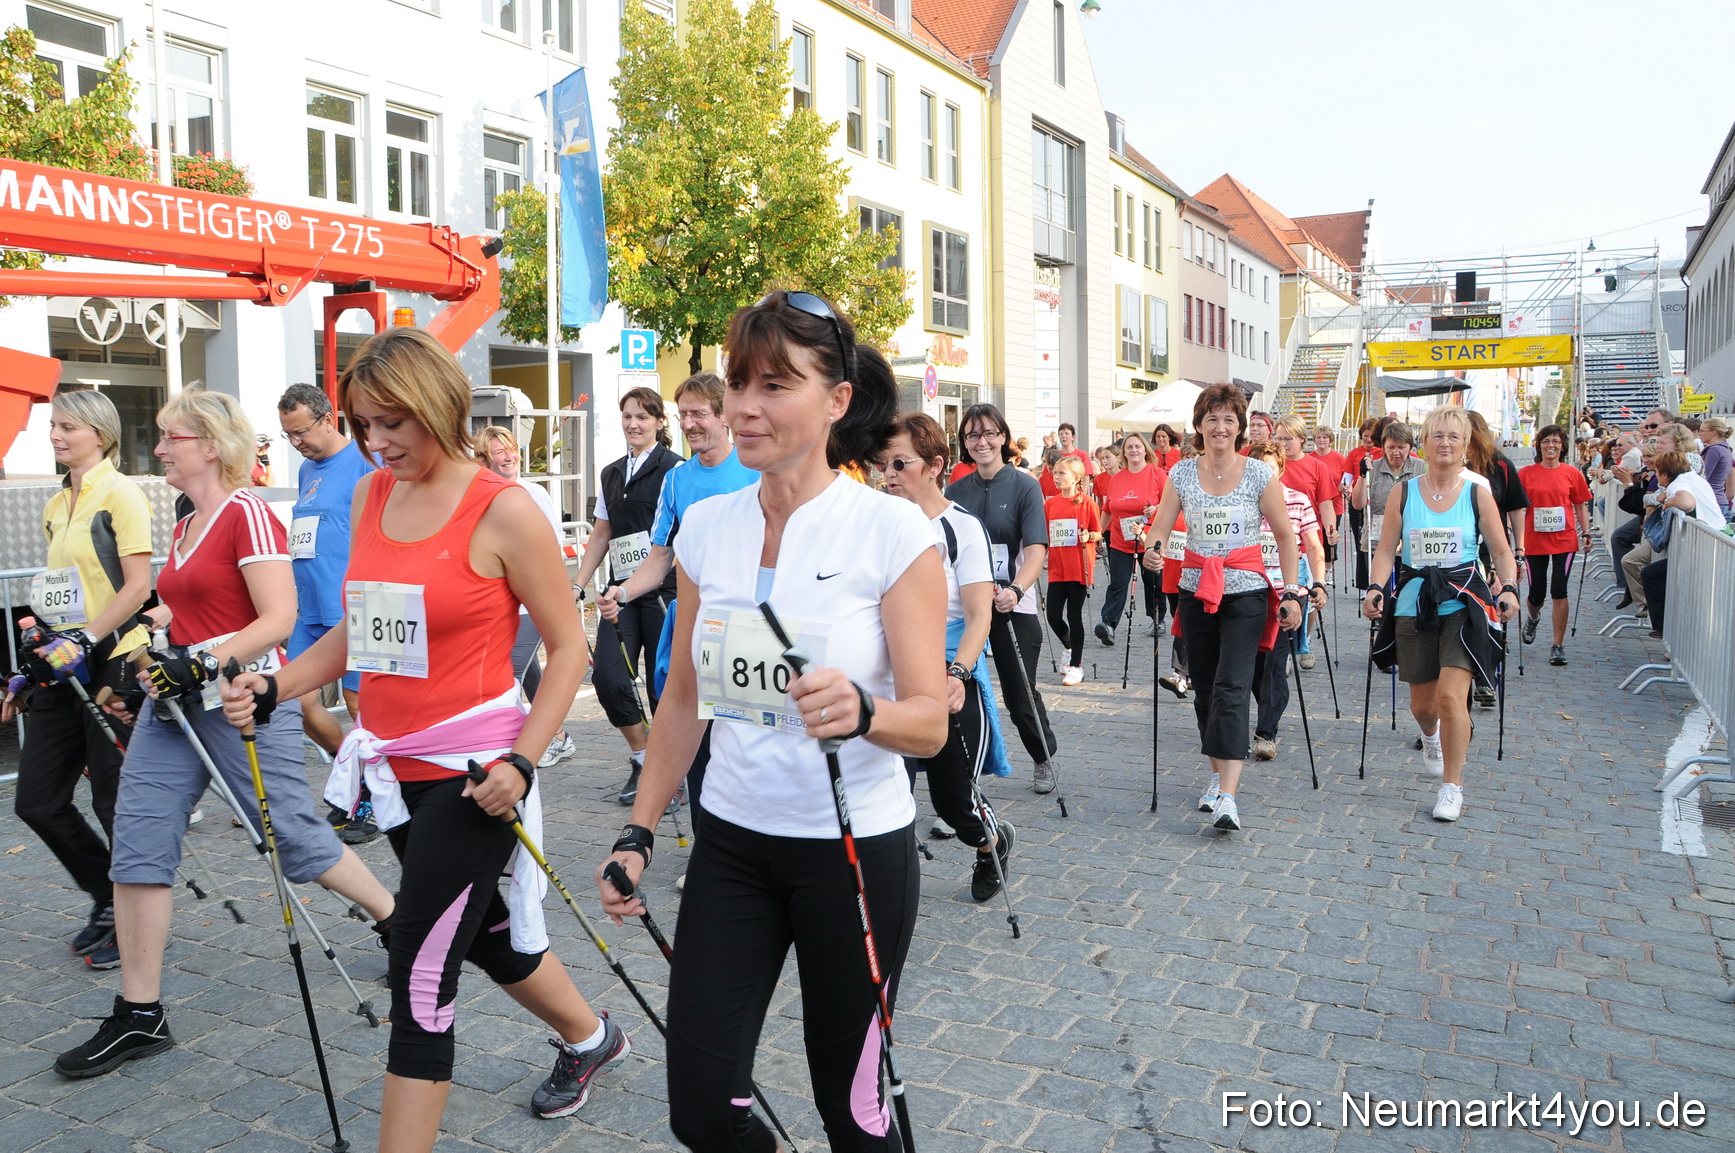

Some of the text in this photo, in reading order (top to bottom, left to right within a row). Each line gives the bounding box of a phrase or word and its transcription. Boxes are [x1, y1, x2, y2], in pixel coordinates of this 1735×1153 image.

[301, 216, 320, 249] T
[331, 221, 384, 258] 275
[628, 334, 648, 365] P
[1430, 343, 1501, 361] START
[1203, 510, 1227, 519] Karola
[1542, 516, 1563, 524] 8069
[1055, 529, 1075, 538] 8082
[1205, 522, 1240, 536] 8073
[1422, 530, 1455, 540] Walburga
[615, 540, 632, 550] Petra
[1424, 542, 1458, 554] 8072
[619, 547, 649, 565] 8086
[45, 572, 69, 586] Monika
[45, 587, 78, 607] 8051
[351, 614, 357, 626] N
[372, 616, 418, 645] 8107
[702, 649, 710, 666] N
[713, 706, 746, 718] BOCK
[260, 798, 275, 836] LEKI
[543, 862, 567, 892] LEKI
